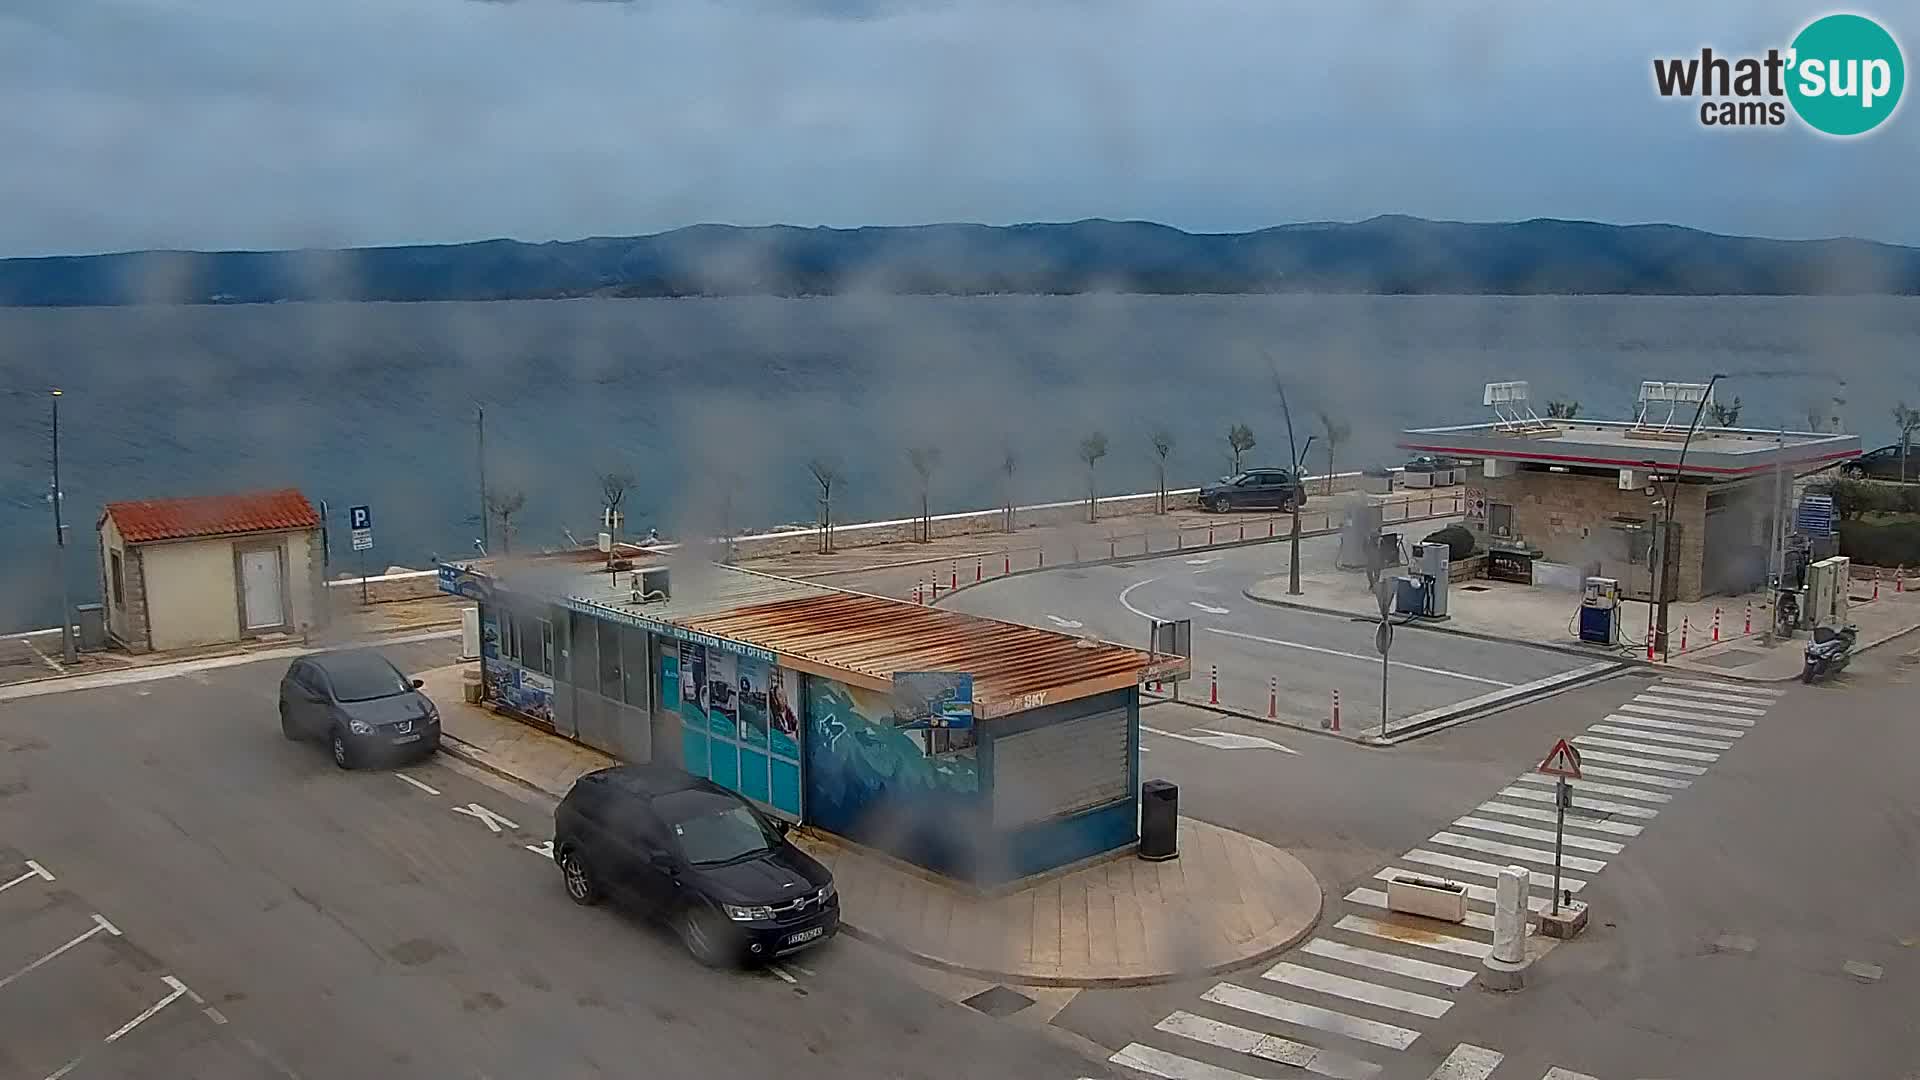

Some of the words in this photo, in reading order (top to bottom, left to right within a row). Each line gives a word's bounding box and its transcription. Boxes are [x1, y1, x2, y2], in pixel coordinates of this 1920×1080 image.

[355, 509, 366, 527] P
[674, 627, 688, 639] BUS
[689, 632, 720, 647] STATION
[722, 640, 746, 654] TICKET
[747, 646, 774, 662] OFFICE
